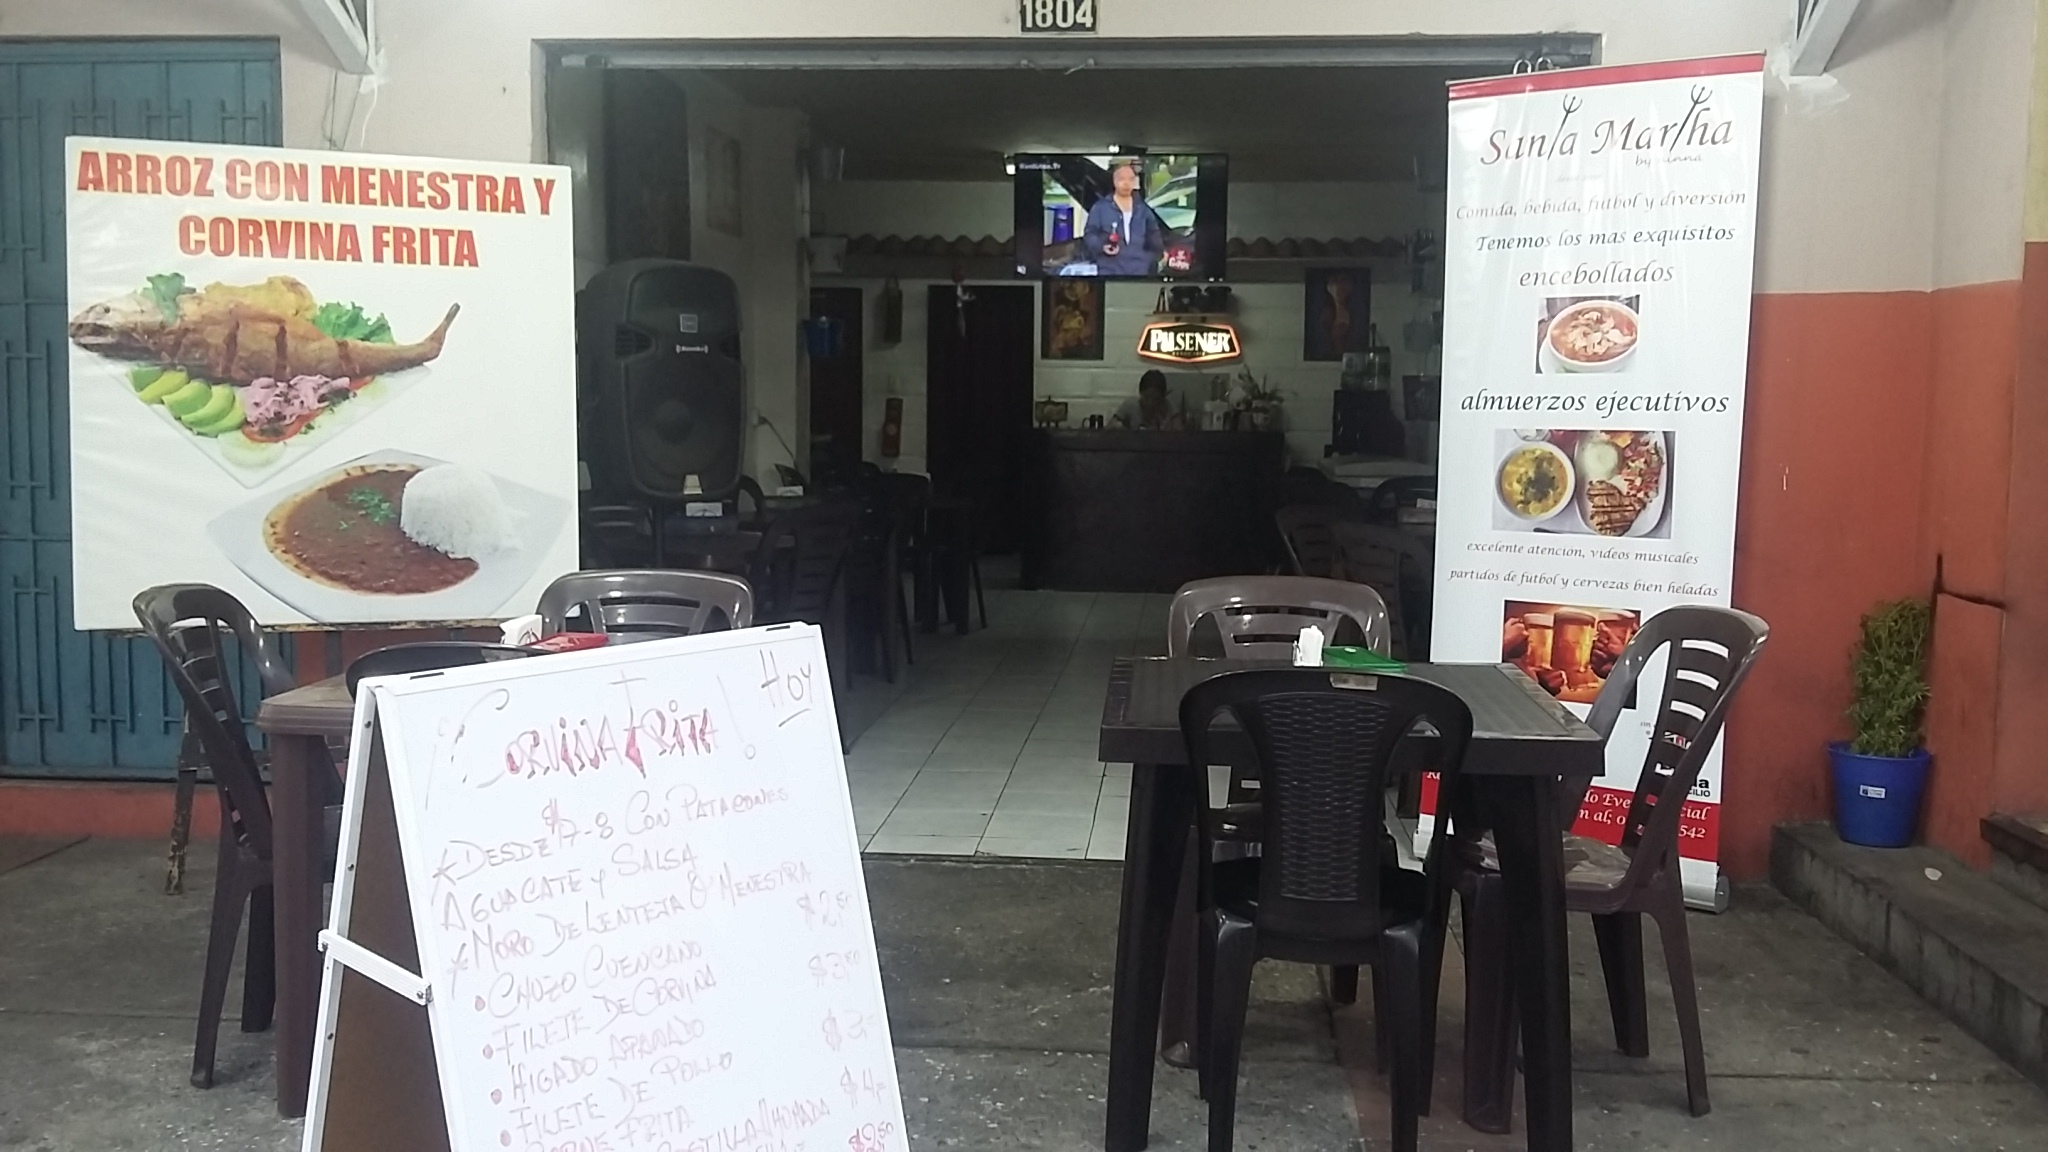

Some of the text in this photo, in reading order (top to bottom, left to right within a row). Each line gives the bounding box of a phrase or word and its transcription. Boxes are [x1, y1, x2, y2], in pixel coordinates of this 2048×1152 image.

[1022, 0, 1094, 28] 1804
[77, 150, 556, 215] ARROZ CON MENESTRA Y
[1456, 201, 1517, 219] Comida,
[1523, 198, 1582, 215] bebida,
[1644, 196, 1654, 213] y
[178, 214, 479, 268] CORVINA FRITA
[1476, 225, 1736, 252] Tenemos los mas exquisitos
[1519, 259, 1675, 287] encebollados
[1150, 329, 1230, 354] PILSENER
[1461, 388, 1730, 419] almuerzos ejecutivos
[1467, 541, 1524, 554] excelente
[1591, 547, 1631, 561] videos
[1635, 551, 1699, 565] musicales
[1447, 568, 1720, 597] partidos de futbol y cervezas bien heladas
